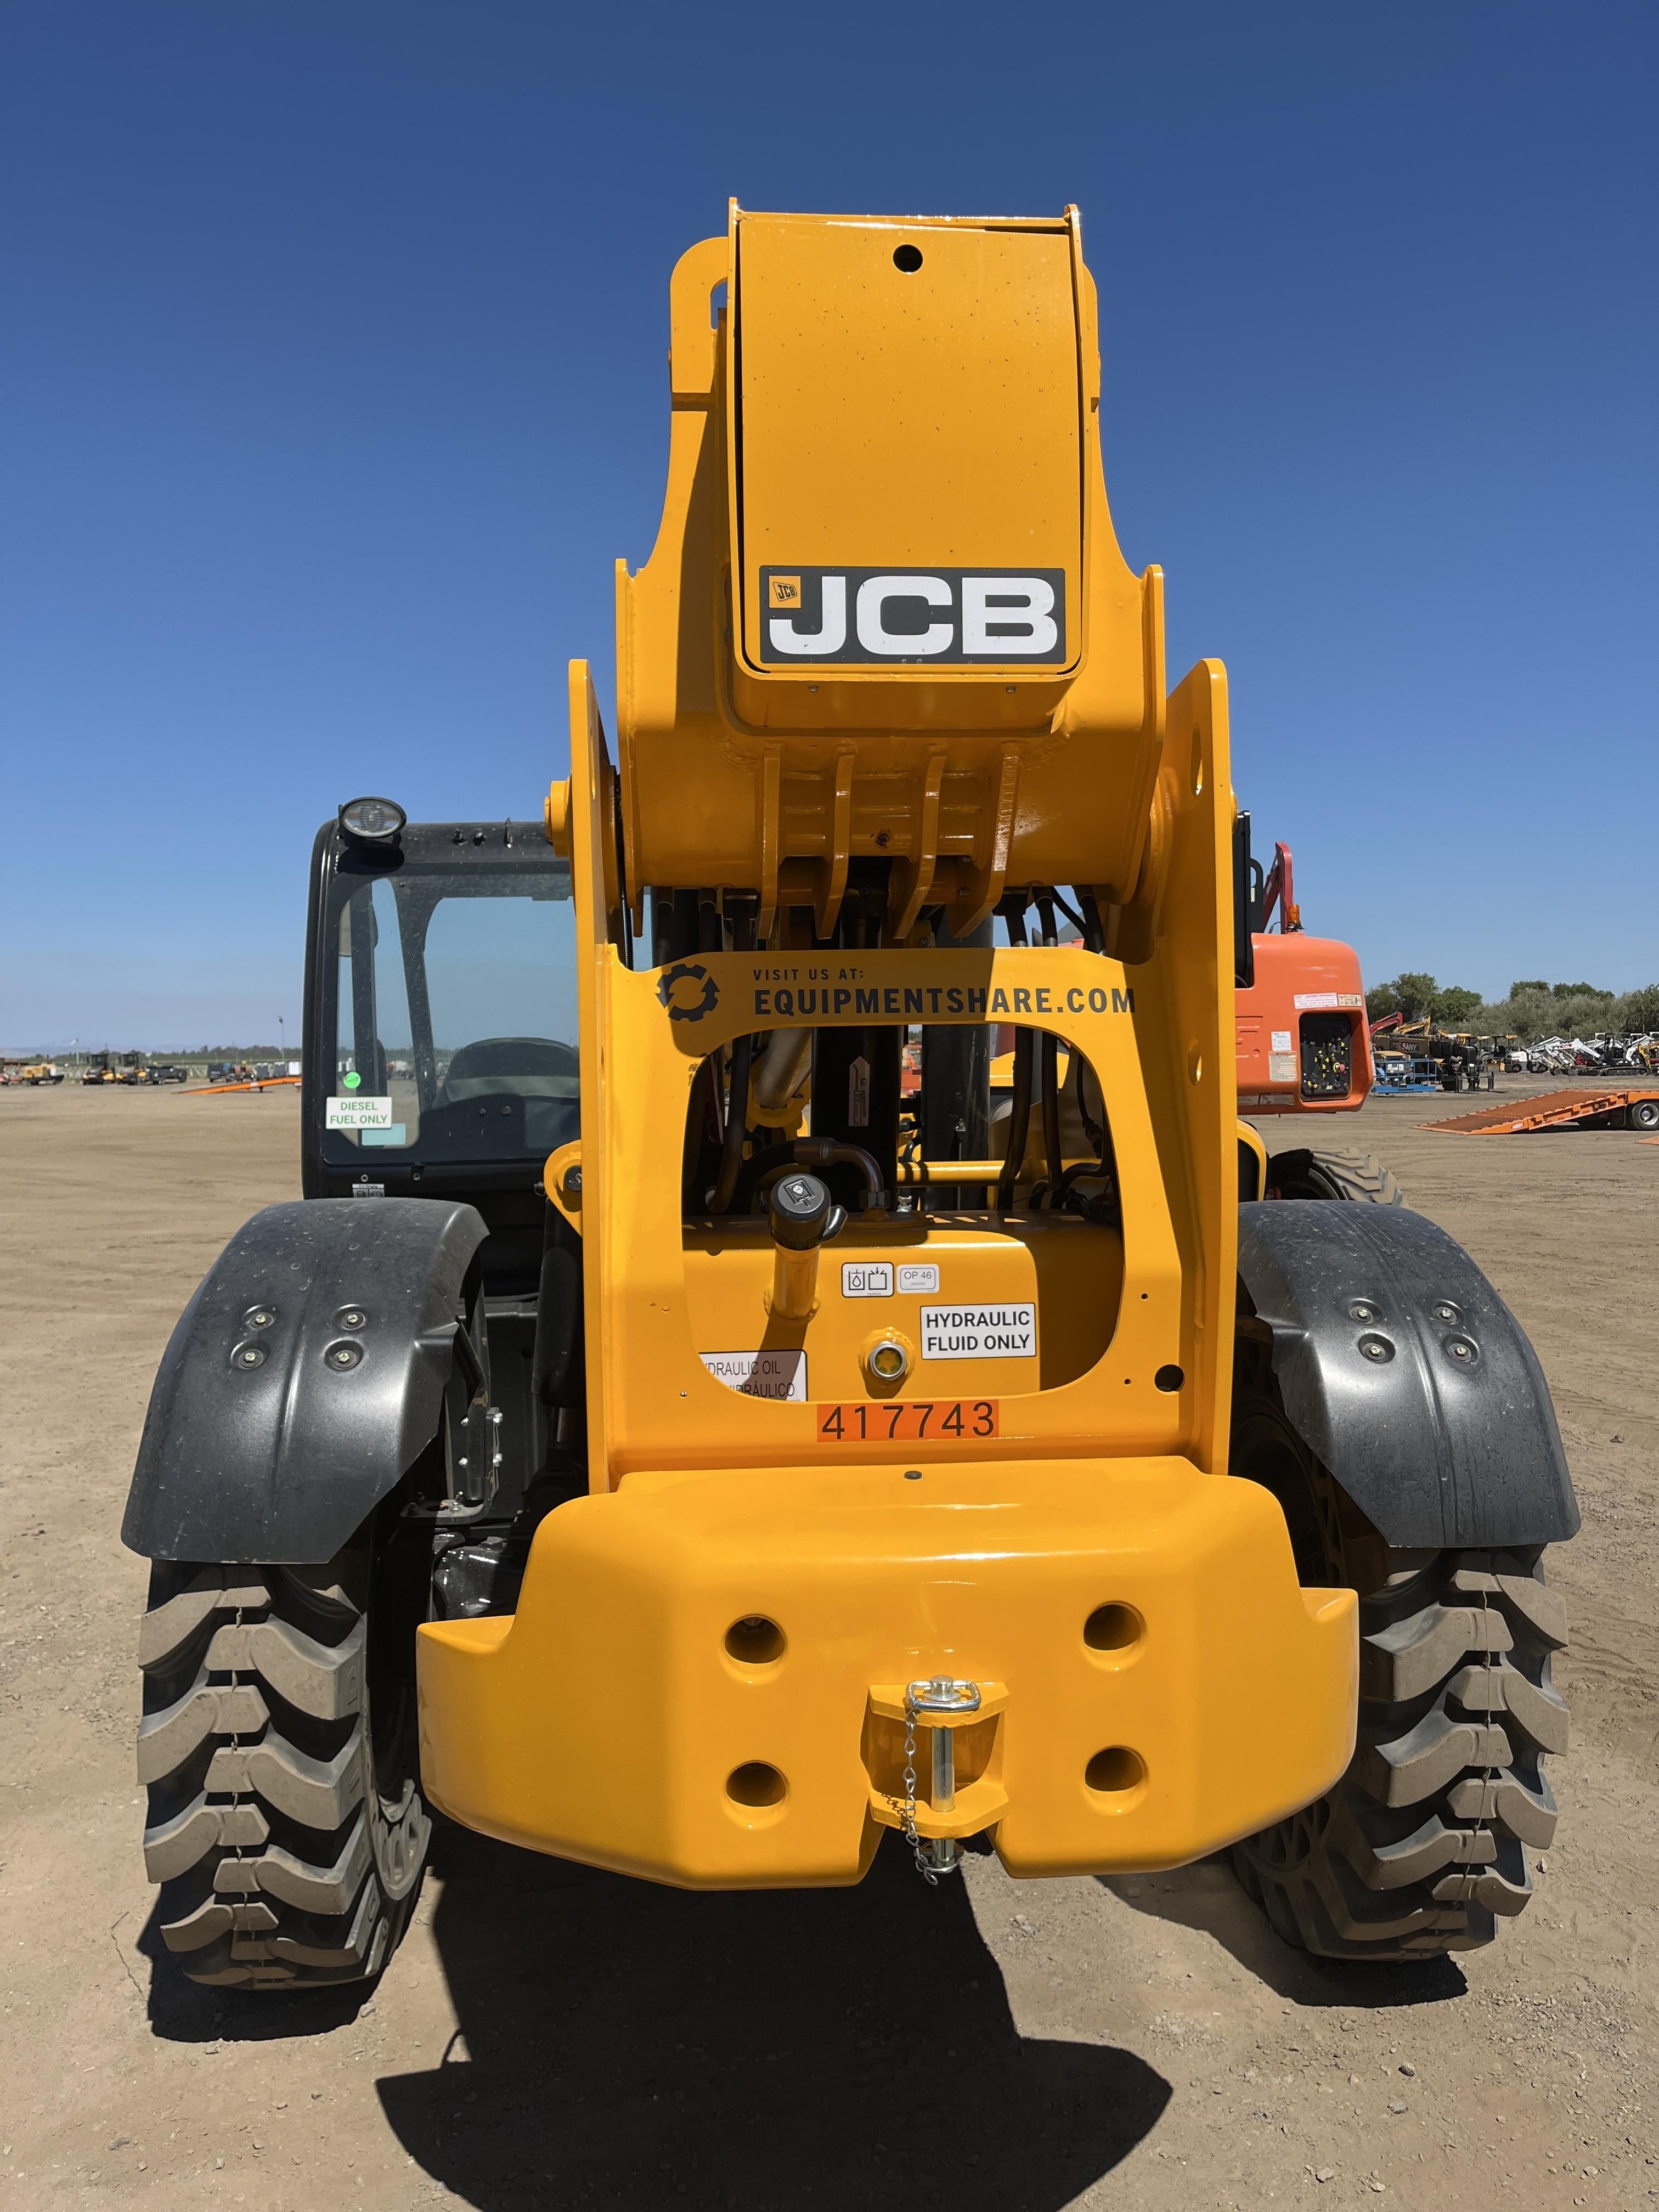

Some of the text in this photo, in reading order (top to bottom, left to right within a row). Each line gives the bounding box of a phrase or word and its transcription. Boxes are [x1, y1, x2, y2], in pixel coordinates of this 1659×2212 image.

[777, 584, 795, 599] JCB
[769, 575, 1058, 655] JCB
[753, 968, 864, 981] VISIT US AT:
[755, 988, 1136, 1017] EQUIPMENTSHARE.COM
[1402, 1043, 1417, 1051] SANY
[341, 1102, 377, 1111] DIESEL
[330, 1115, 387, 1124] FUEL ONLY
[904, 1271, 932, 1279] OP 46
[926, 1311, 1030, 1328] HYDRAULIC
[928, 1334, 1030, 1351] FLUID ONLY
[705, 1360, 781, 1376] DRAULIC OIL
[730, 1380, 795, 1397] DRÁULICO
[821, 1402, 994, 1440] 417743
